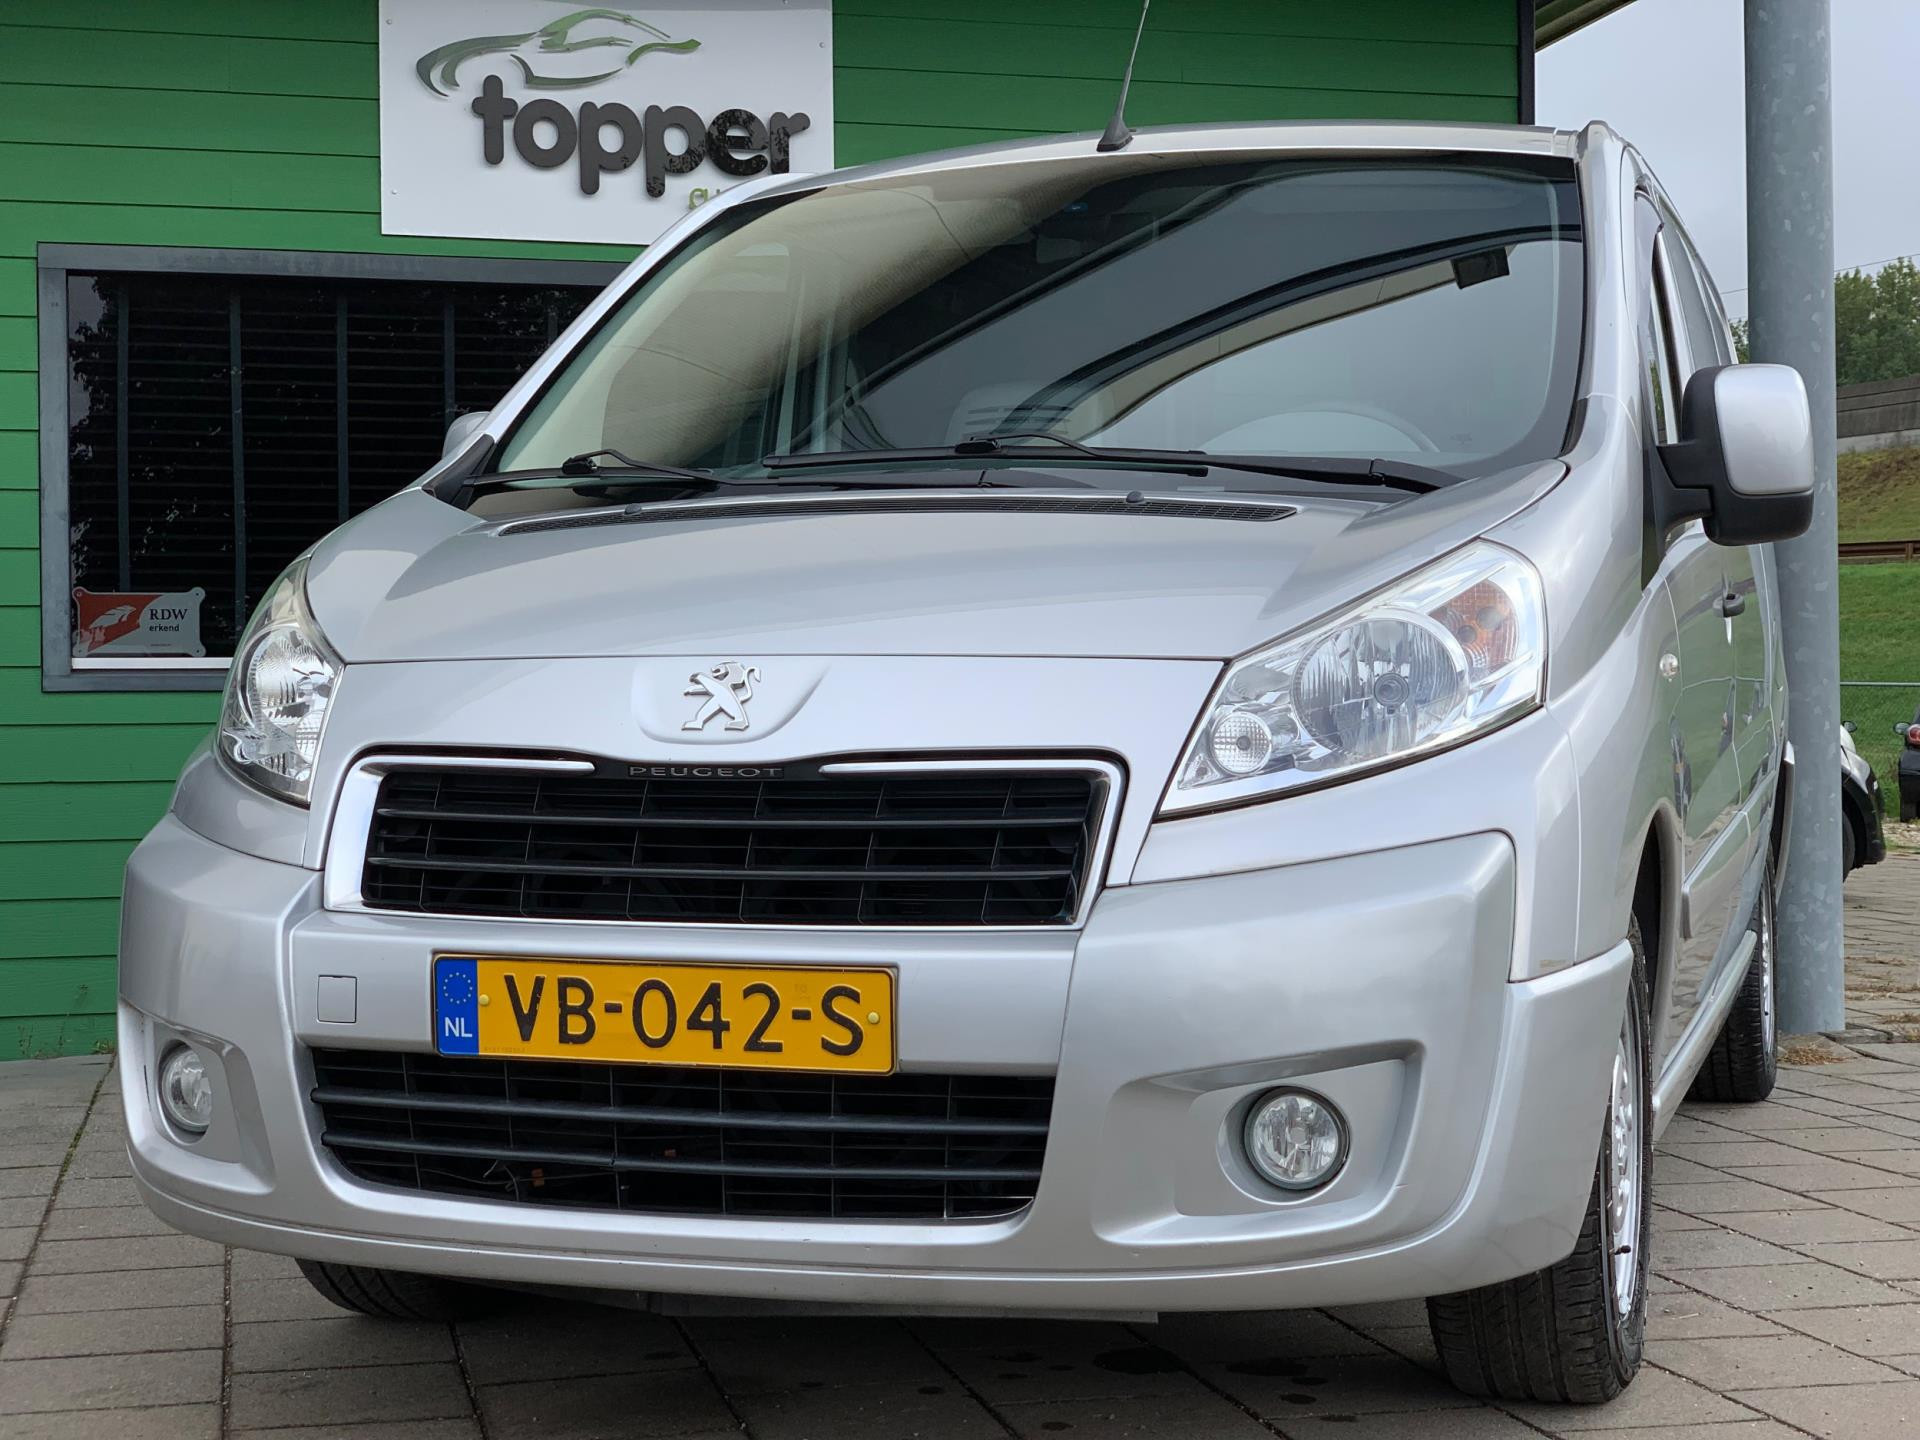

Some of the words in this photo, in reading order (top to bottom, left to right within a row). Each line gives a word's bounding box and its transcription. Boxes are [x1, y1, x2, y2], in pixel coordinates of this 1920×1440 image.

[472, 74, 811, 198] topper
[149, 608, 188, 620] RDW
[149, 624, 180, 632] erkend
[629, 766, 783, 777] PEUGEOT
[503, 974, 865, 1056] VB-042-S
[444, 1017, 473, 1038] NL
